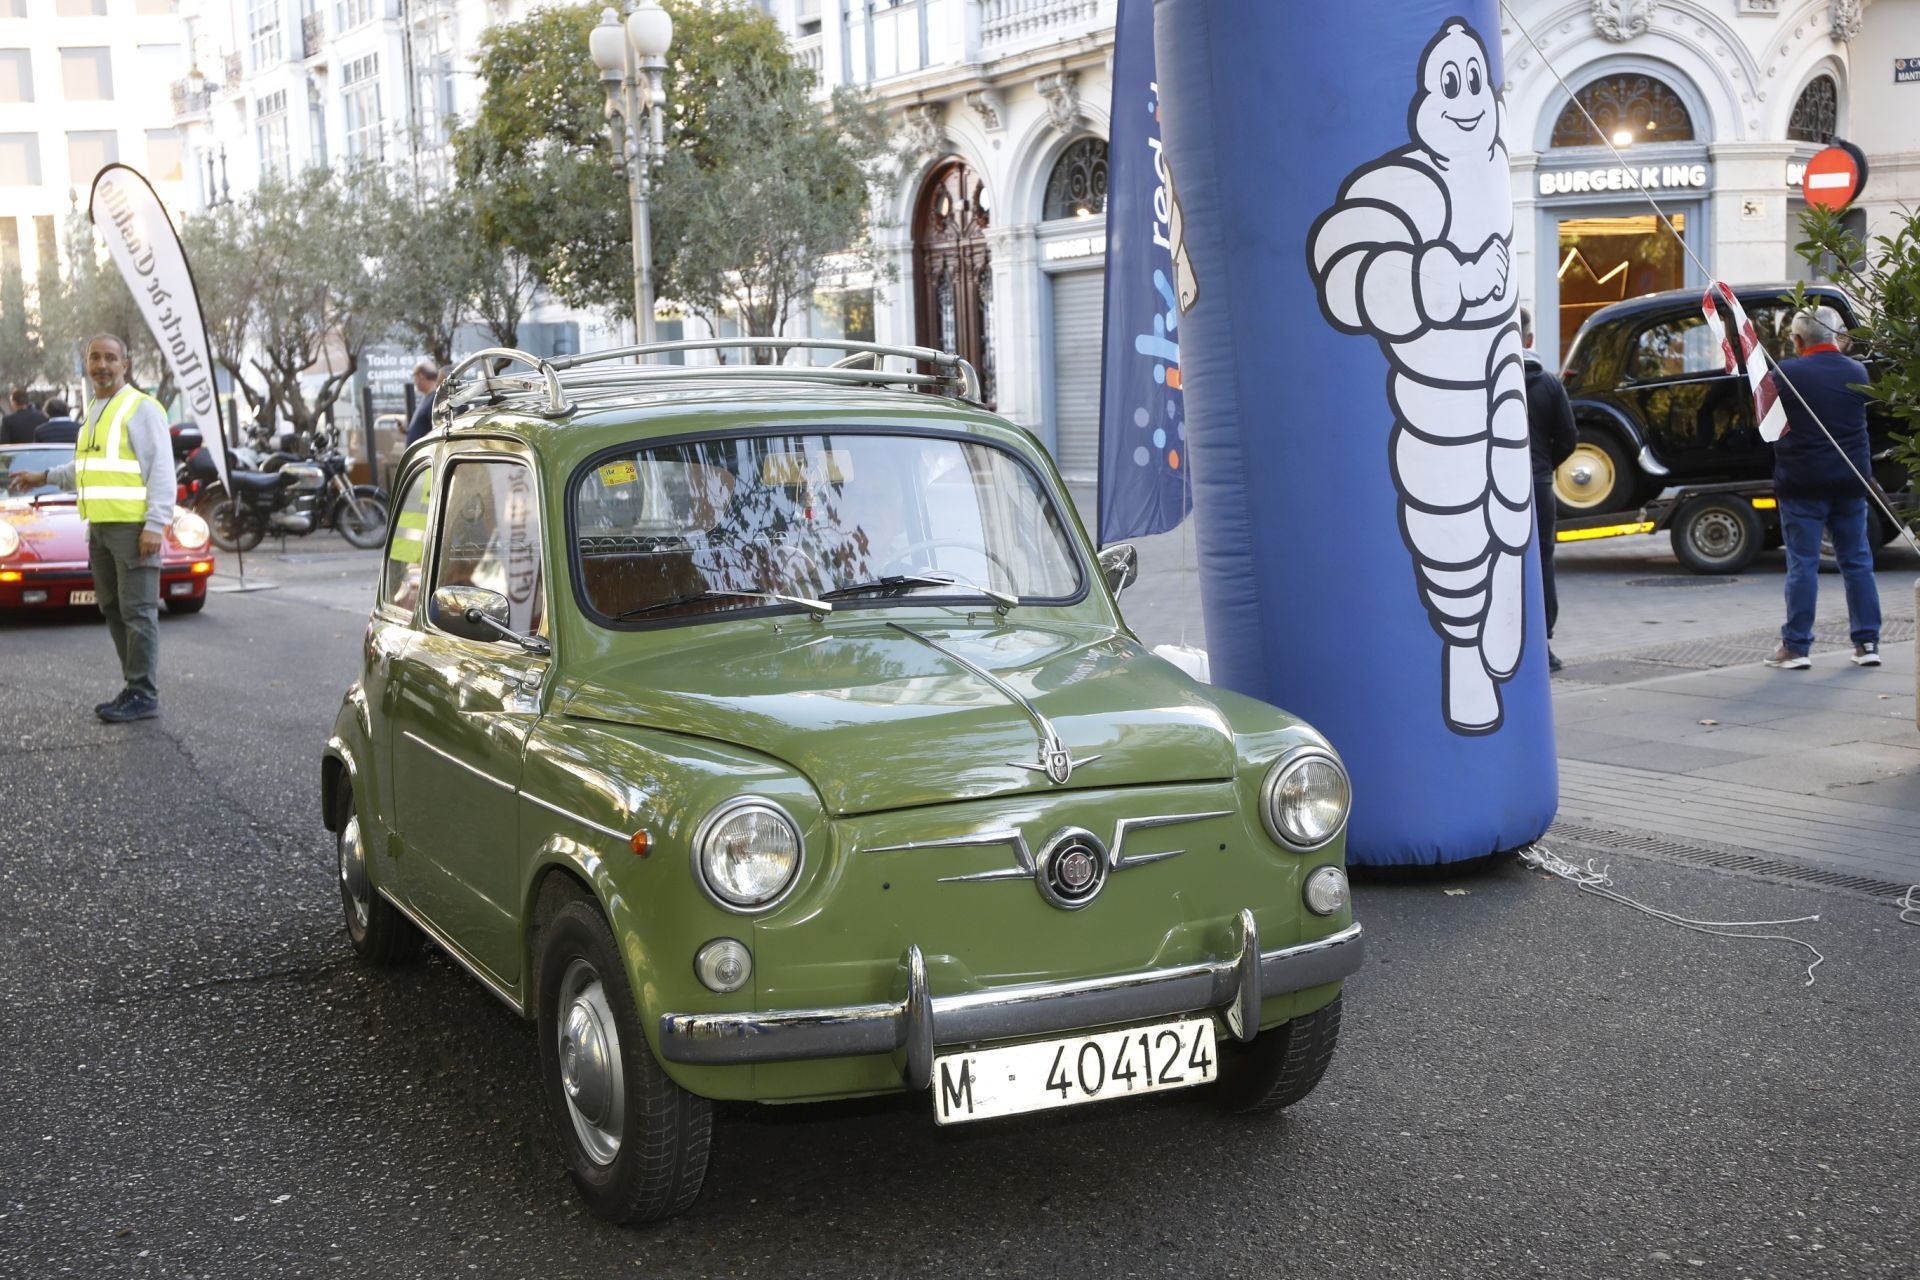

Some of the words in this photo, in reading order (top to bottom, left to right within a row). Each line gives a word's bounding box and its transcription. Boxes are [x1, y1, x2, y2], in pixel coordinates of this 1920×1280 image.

[1539, 167, 1639, 195] BURGER
[1641, 165, 1706, 189] KING
[366, 354, 397, 366] Todo
[940, 1058, 974, 1117] M
[1045, 1023, 1212, 1100] 404124
